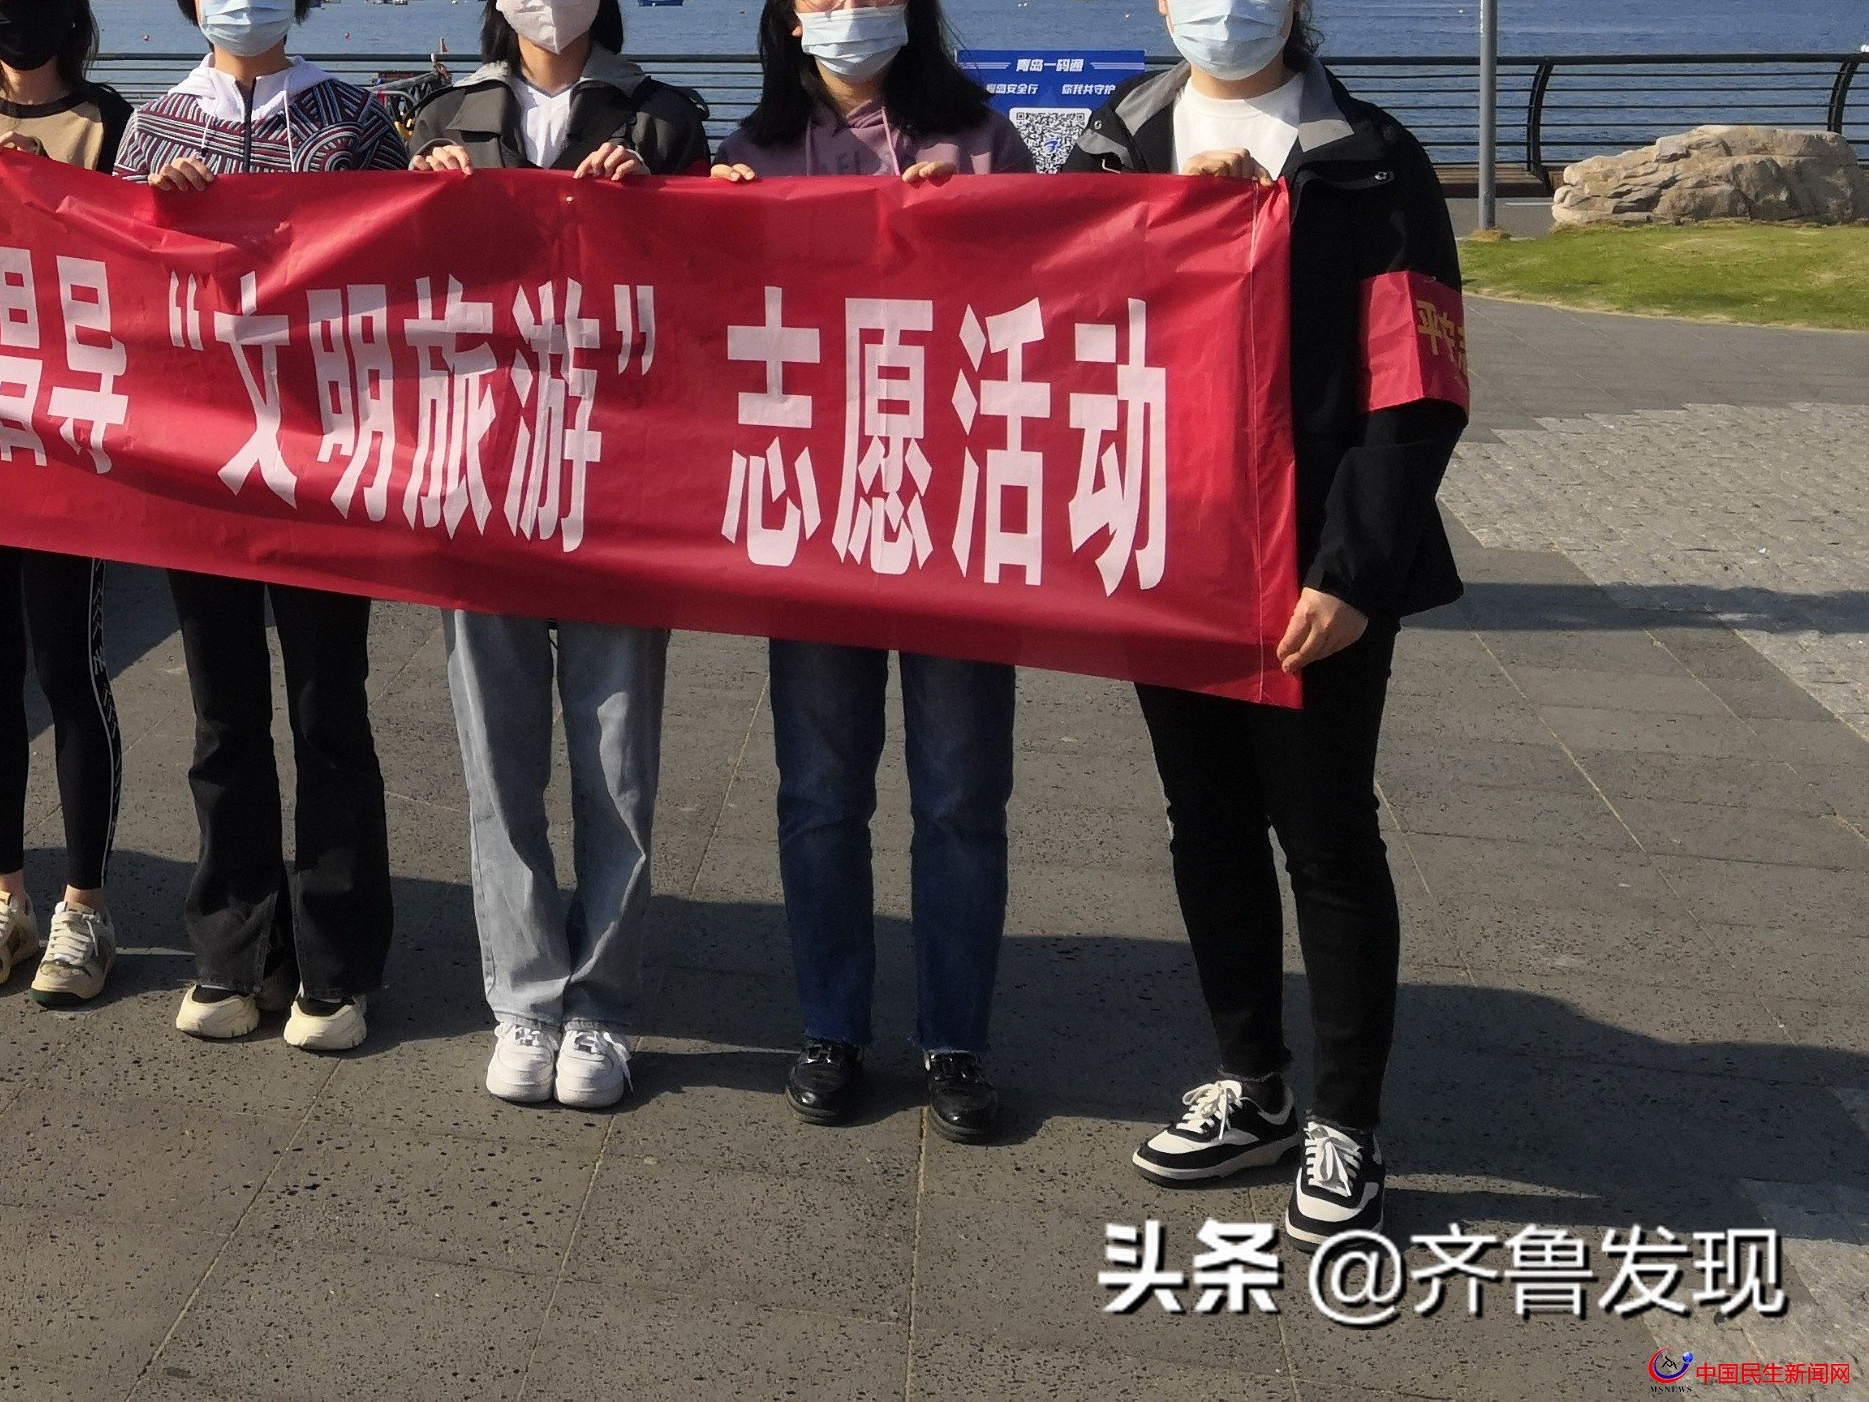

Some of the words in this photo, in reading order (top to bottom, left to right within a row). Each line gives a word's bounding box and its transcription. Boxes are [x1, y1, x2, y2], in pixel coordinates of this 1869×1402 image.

[1016, 58, 1084, 72] 青岛一码通
